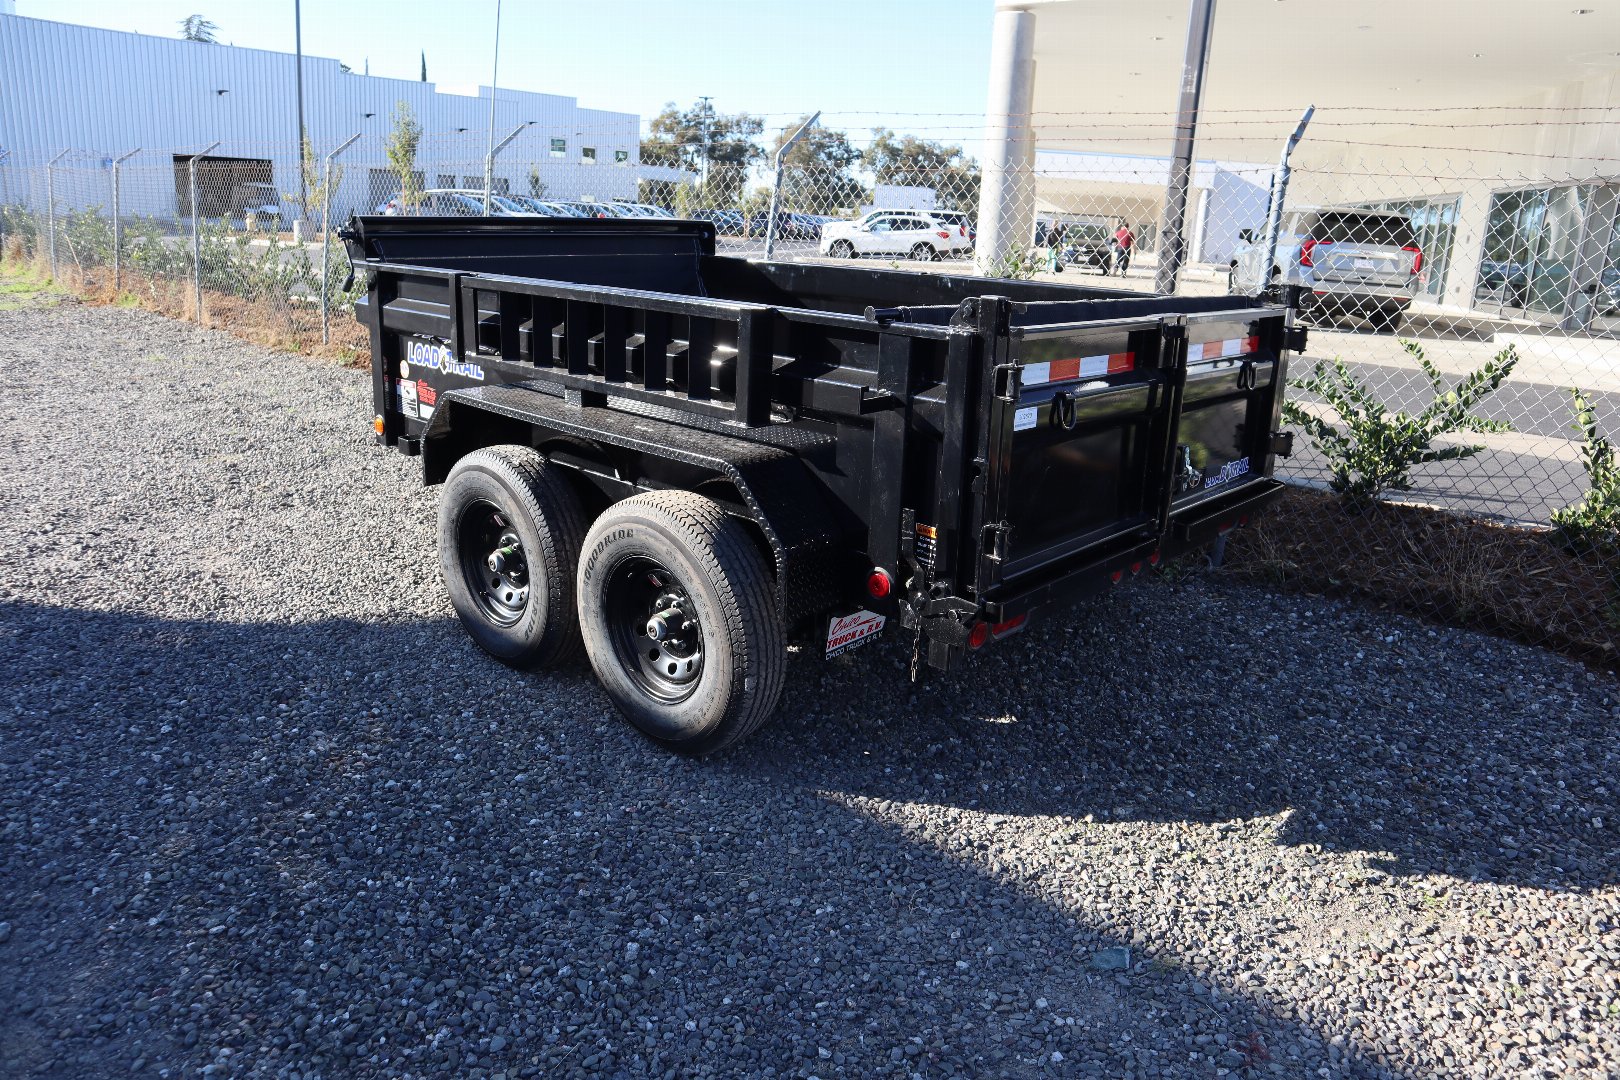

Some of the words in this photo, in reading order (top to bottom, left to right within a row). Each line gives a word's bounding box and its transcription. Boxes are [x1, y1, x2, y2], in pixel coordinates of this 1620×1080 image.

[407, 341, 441, 369] LOAD
[827, 630, 858, 649] TRUCK
[846, 638, 866, 651] TRUCK
